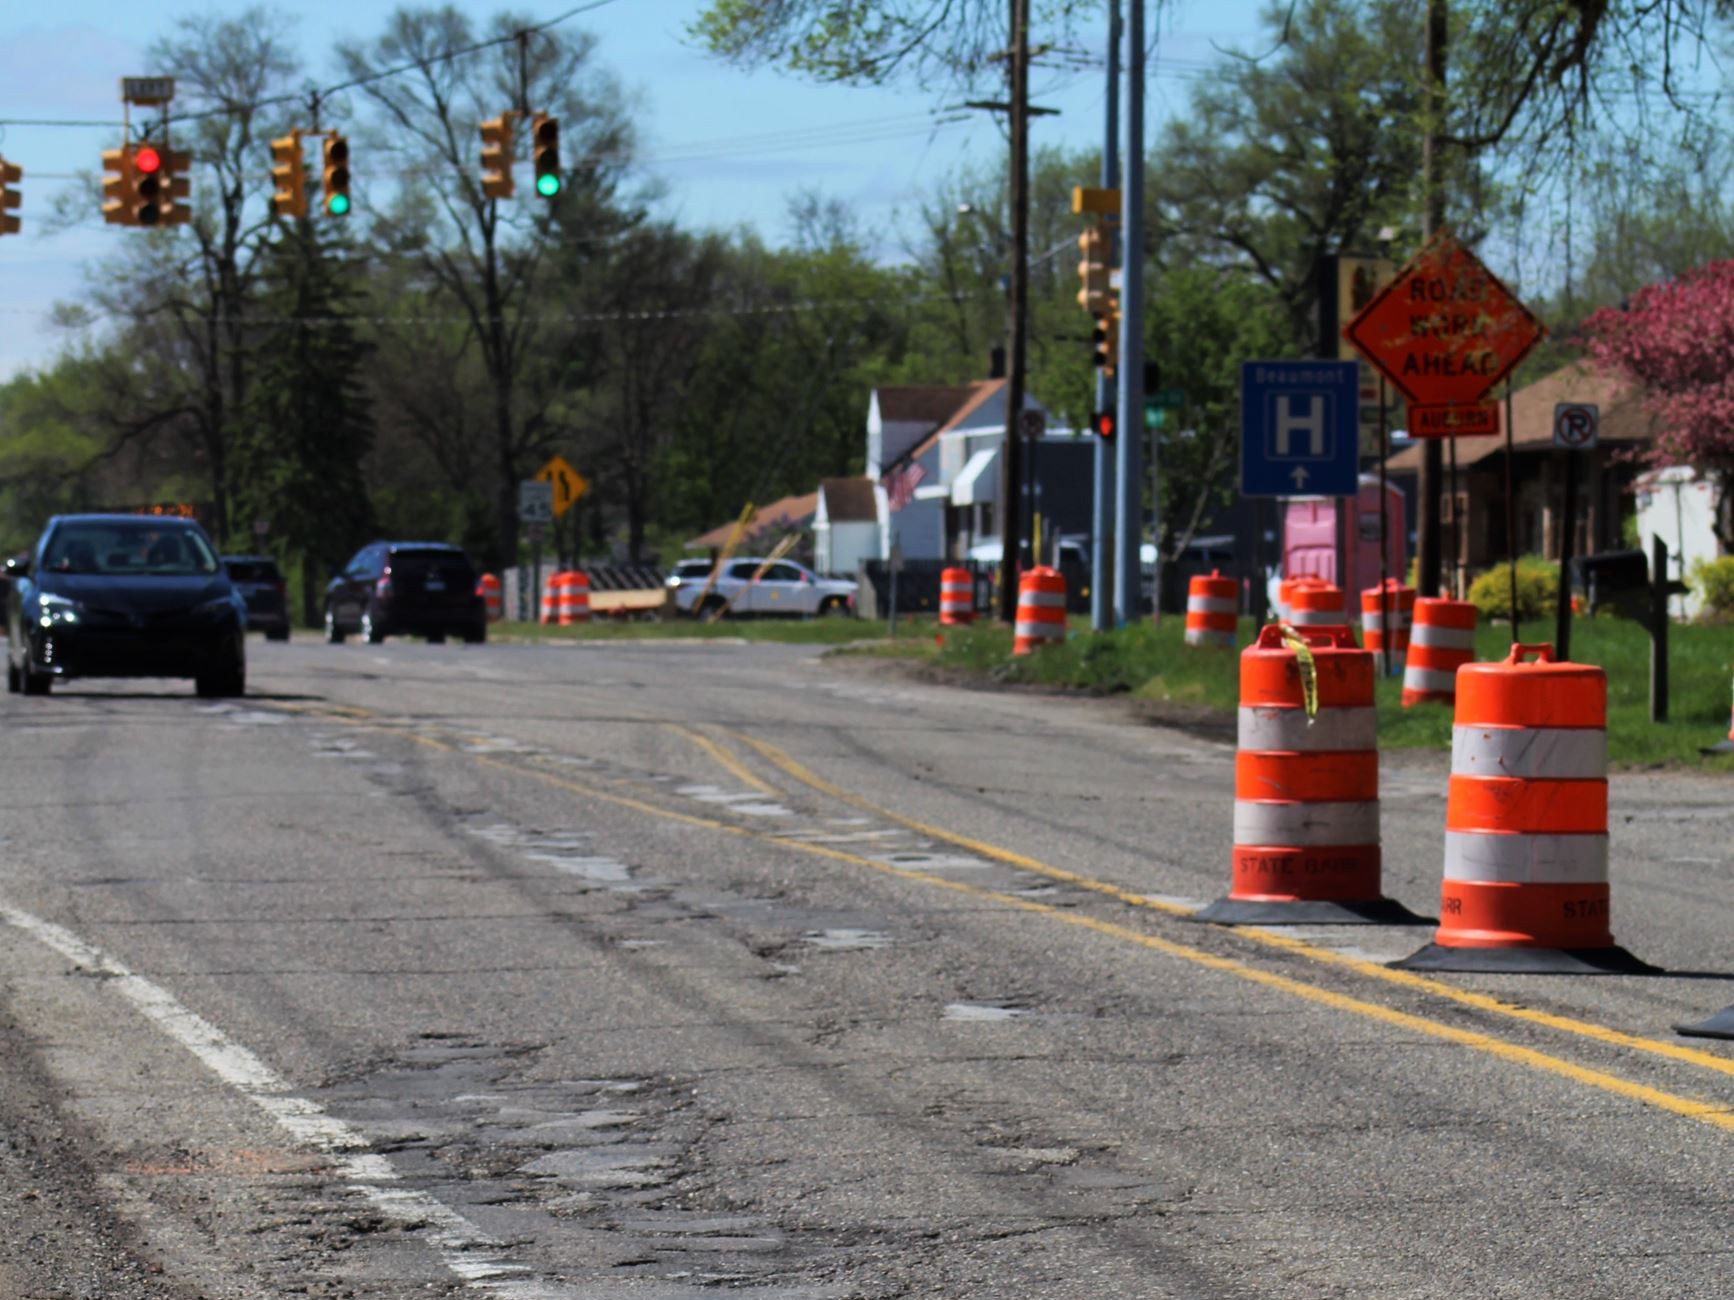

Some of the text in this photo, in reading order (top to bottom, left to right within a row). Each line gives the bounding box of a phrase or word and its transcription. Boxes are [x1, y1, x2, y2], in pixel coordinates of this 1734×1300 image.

[1409, 276, 1487, 302] ROAD
[1402, 351, 1498, 376] AHEAD
[1255, 367, 1344, 385] Beaumont
[1276, 395, 1323, 455] H
[1240, 856, 1295, 875] STATE
[1563, 898, 1609, 920] STAT
